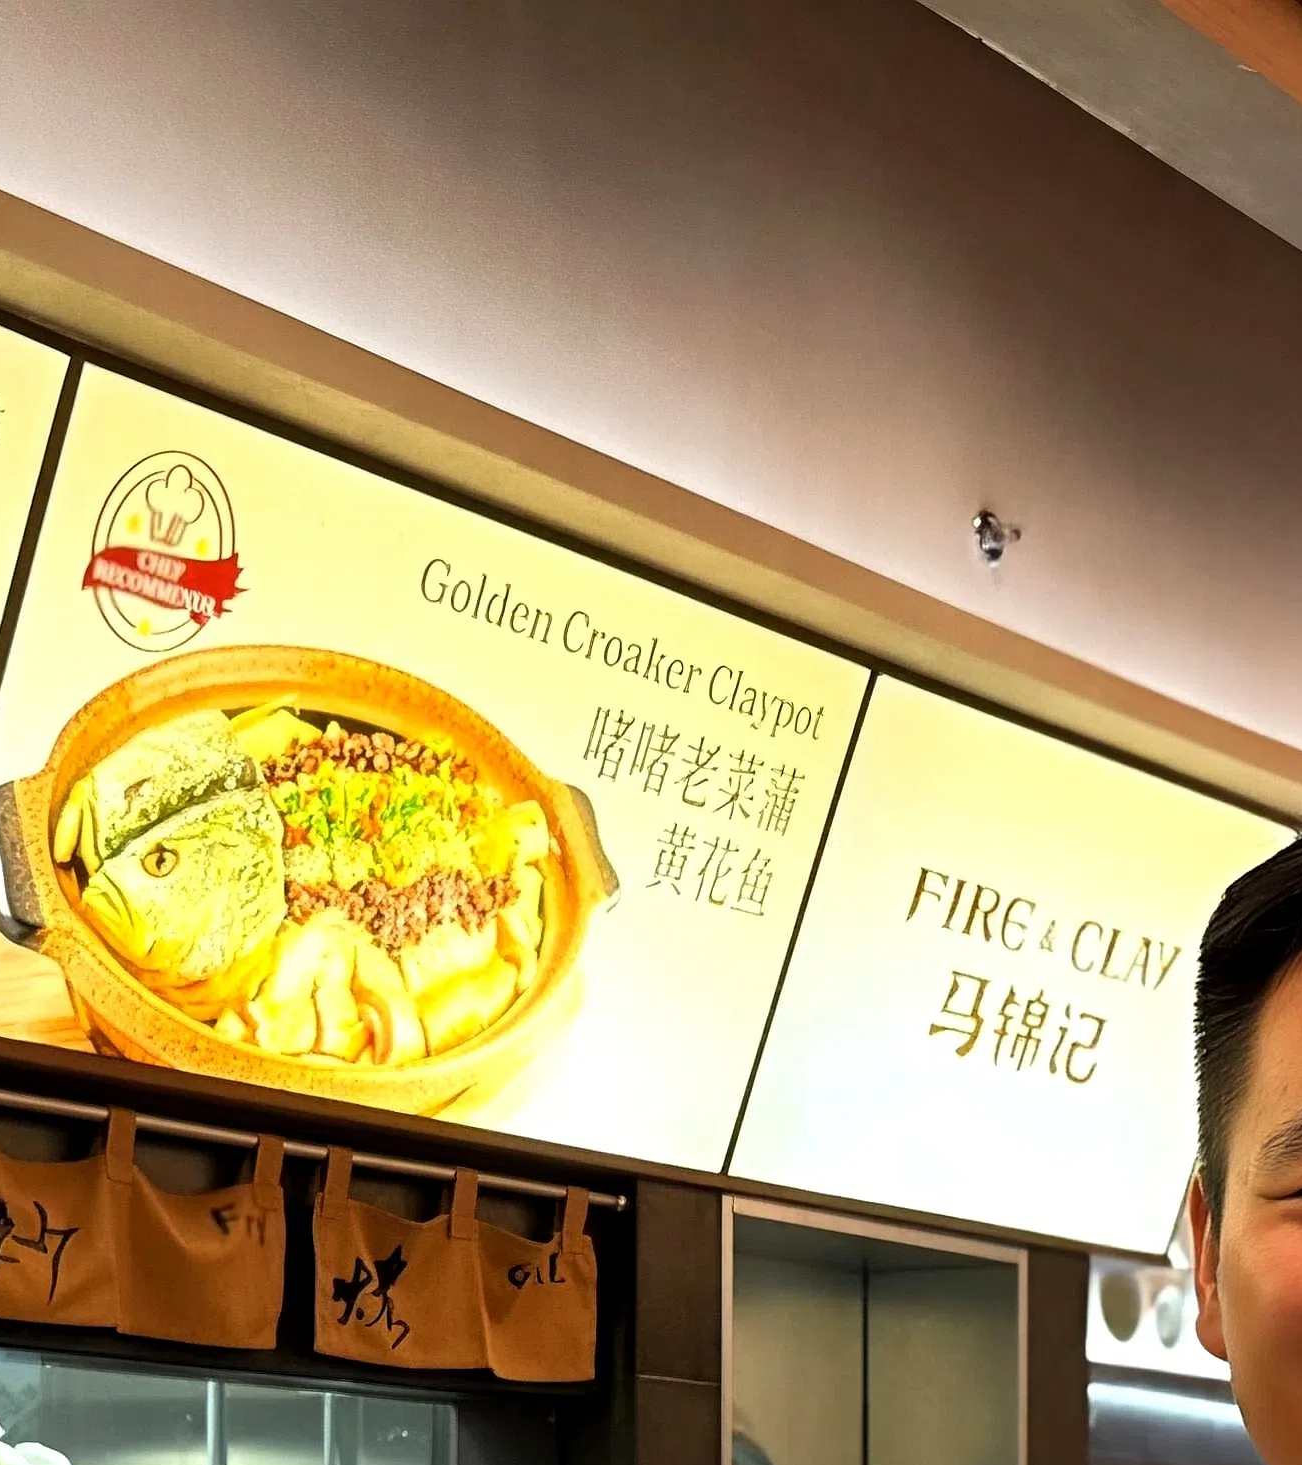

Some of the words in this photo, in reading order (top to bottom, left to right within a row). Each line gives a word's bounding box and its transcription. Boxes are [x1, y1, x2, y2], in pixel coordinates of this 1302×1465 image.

[420, 558, 553, 644] Golden
[562, 610, 703, 695] Croaker
[708, 664, 824, 740] Claypot
[645, 821, 773, 916] 黄花鱼
[905, 866, 1036, 951] FIRE
[1039, 919, 1057, 953] &
[1071, 920, 1182, 990] CLAY
[928, 970, 1108, 1084] 马锦记
